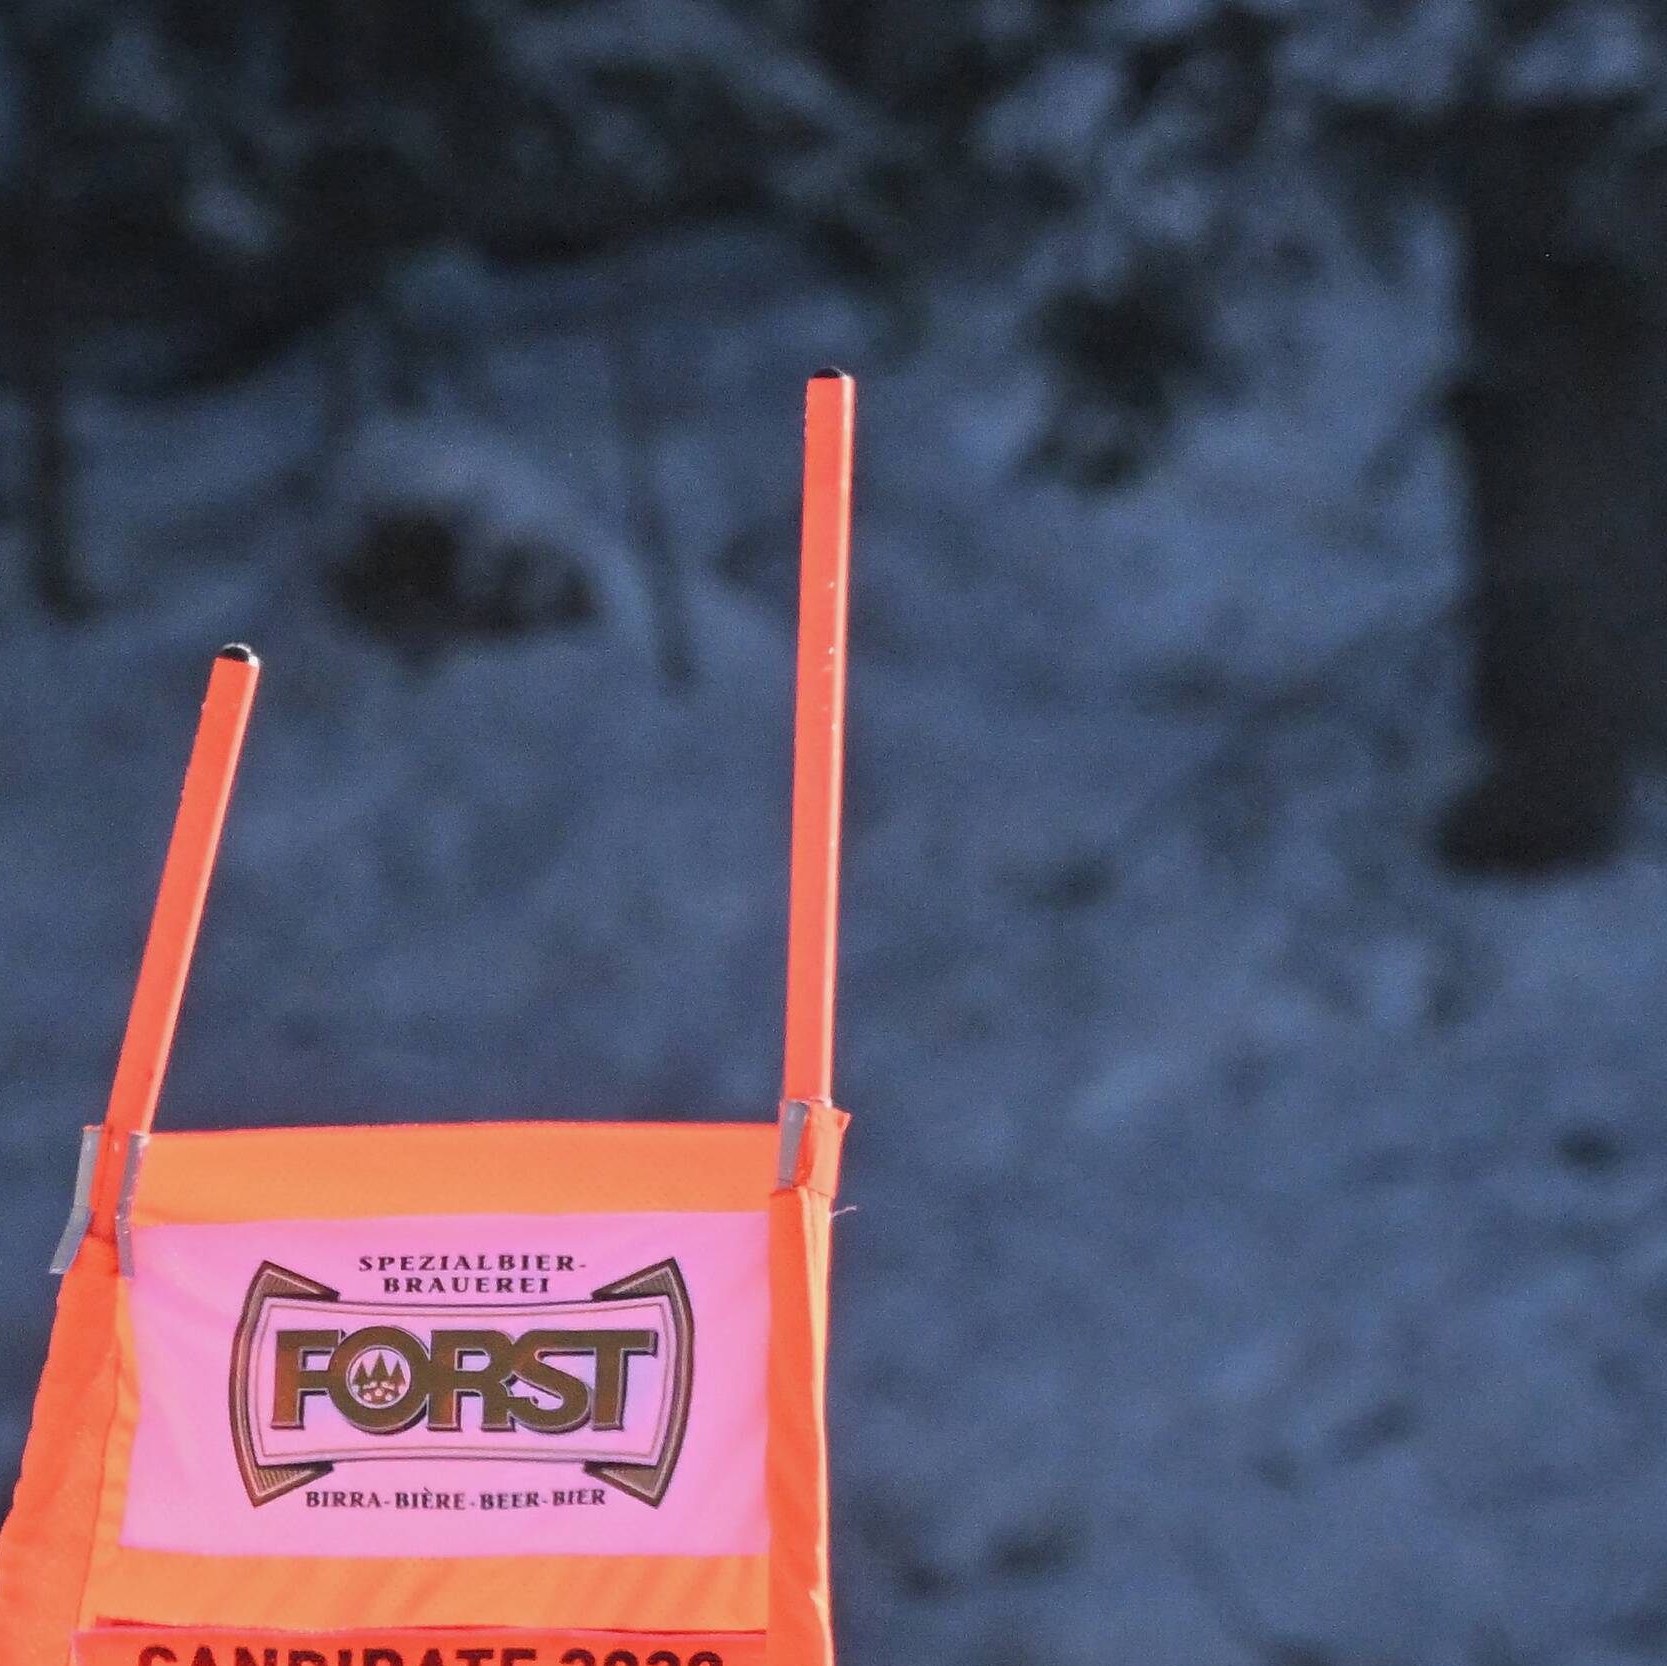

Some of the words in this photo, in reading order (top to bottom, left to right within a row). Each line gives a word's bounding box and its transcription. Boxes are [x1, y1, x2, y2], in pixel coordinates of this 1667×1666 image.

[358, 1254, 587, 1273] SPEZIALBIER-
[382, 1276, 550, 1294] BRAUEREI
[270, 1324, 662, 1435] FORST
